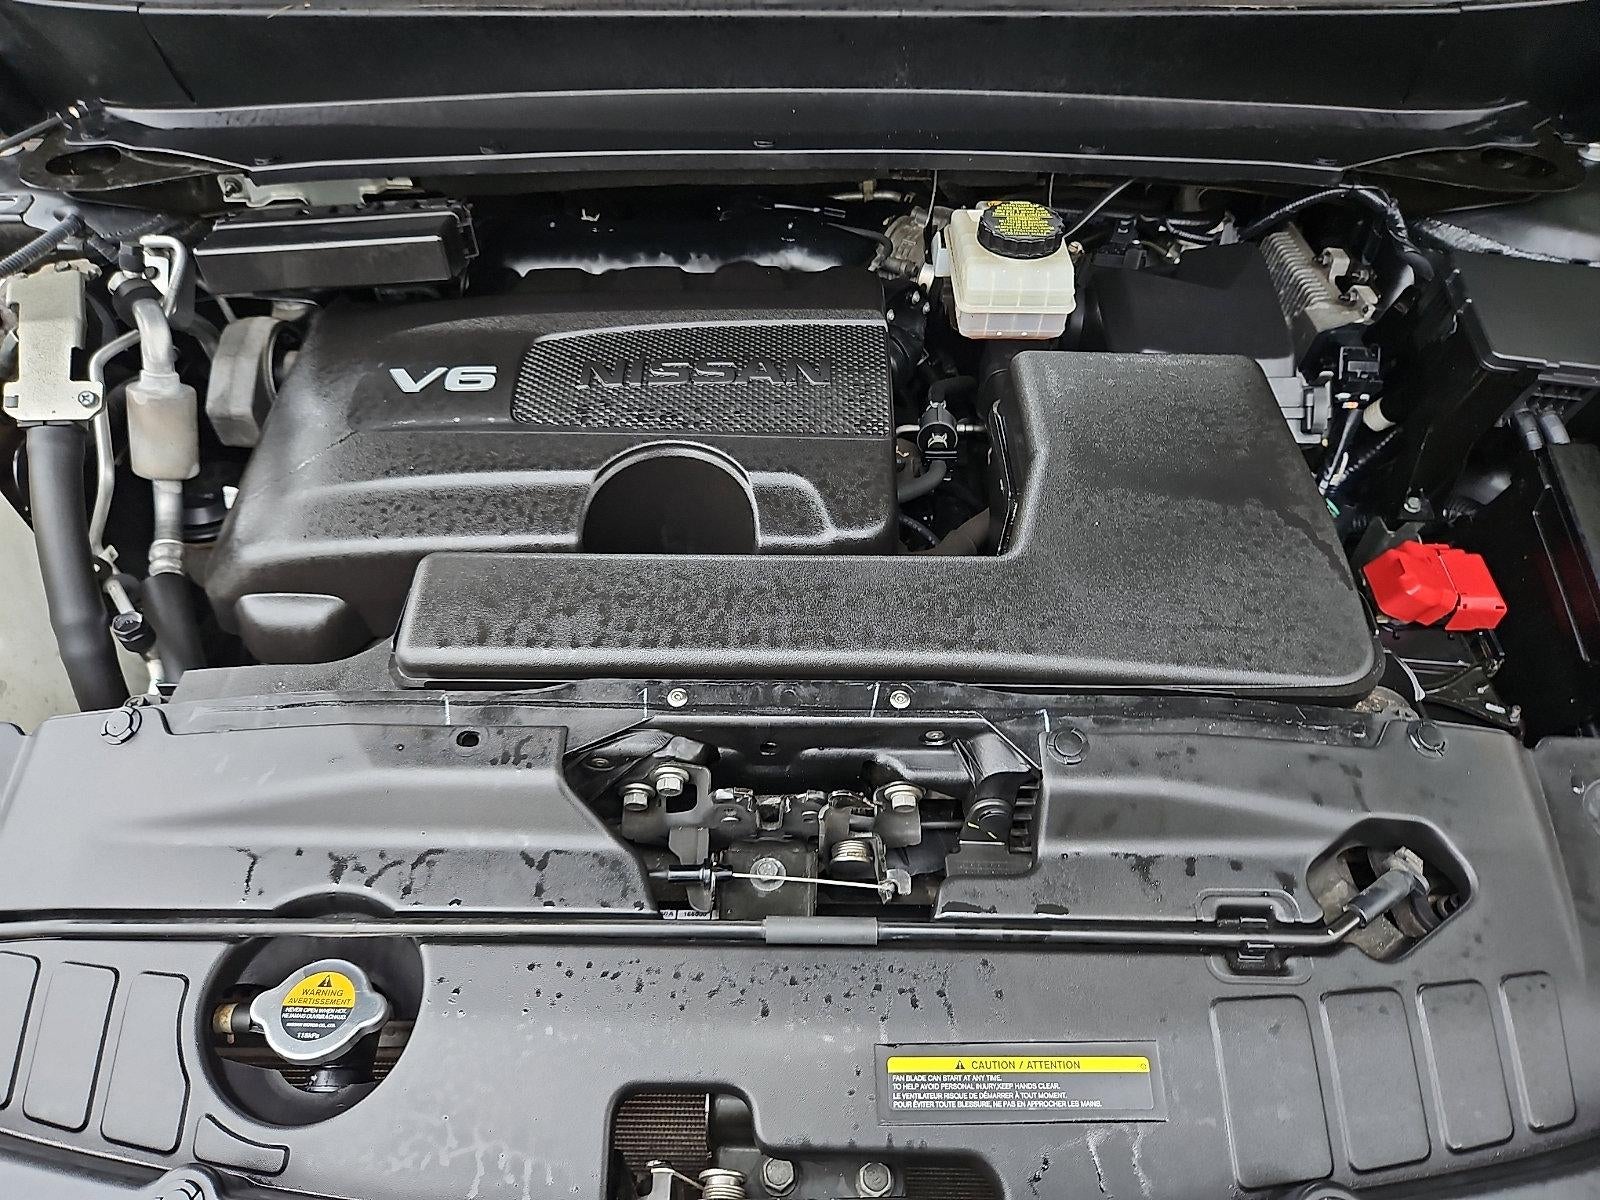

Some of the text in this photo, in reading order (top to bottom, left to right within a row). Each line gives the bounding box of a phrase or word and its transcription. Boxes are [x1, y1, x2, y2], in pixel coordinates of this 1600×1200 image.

[577, 358, 832, 390] NISSAN
[389, 365, 497, 394] V6
[302, 988, 344, 997] WARNING
[287, 997, 352, 1006] AVERTISSEMENT
[971, 1060, 1016, 1070] CAUTION
[1026, 1060, 1081, 1070] ATTENTION
[892, 1074, 1002, 1082] FAN BLADE CAN START AT ANY TIME.
[943, 1092, 968, 1100] RISQUE
[979, 1091, 1014, 1099] DÉMARRER
[893, 1100, 912, 1108] POUR
[913, 1099, 935, 1108] ÉVITER
[935, 1100, 956, 1108] TOUTE
[992, 1100, 1002, 1108] NE
[1003, 1100, 1016, 1108] PAS
[1017, 1100, 1026, 1108] EN
[1026, 1100, 1067, 1108] APPROCHER
[1067, 1100, 1080, 1108] LES
[1080, 1100, 1103, 1108] MAINS.
